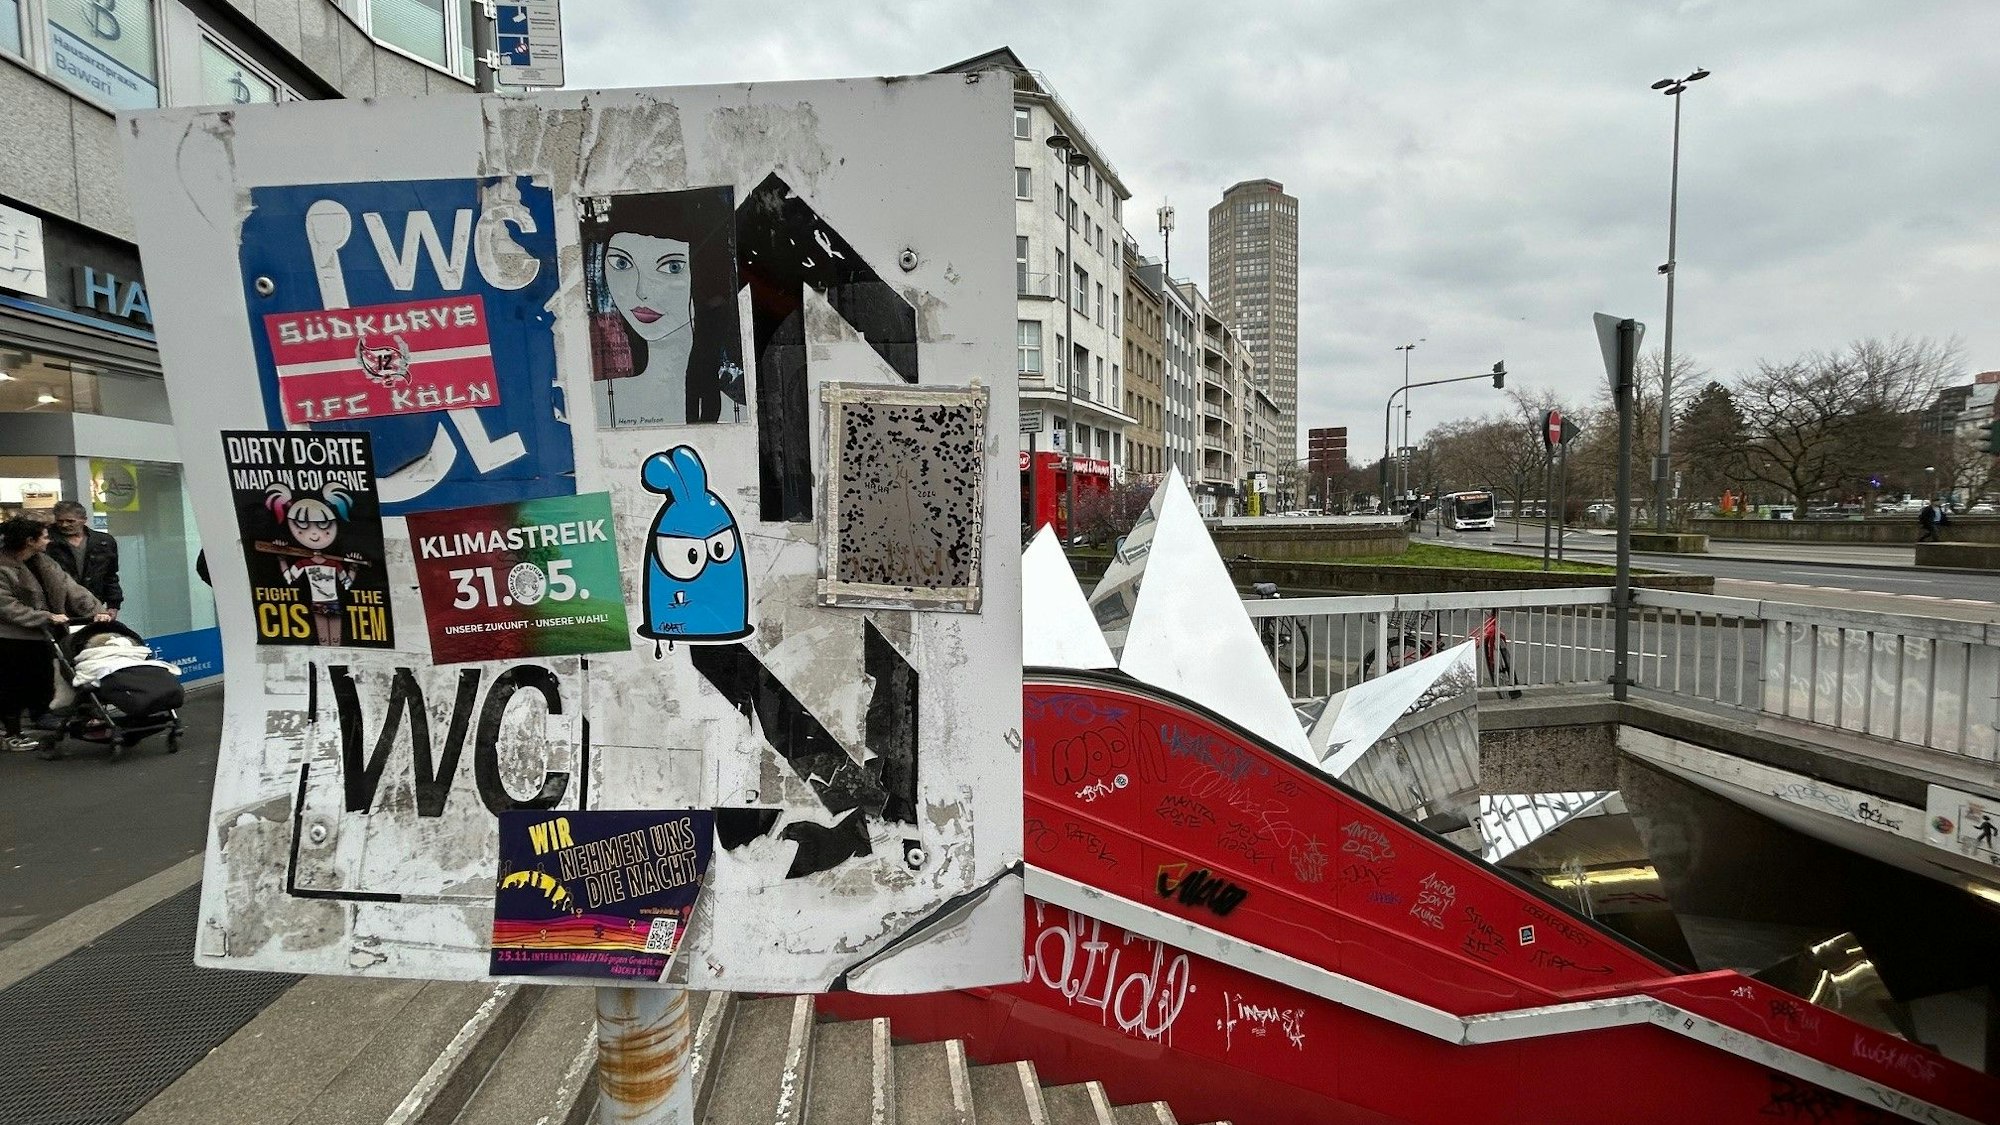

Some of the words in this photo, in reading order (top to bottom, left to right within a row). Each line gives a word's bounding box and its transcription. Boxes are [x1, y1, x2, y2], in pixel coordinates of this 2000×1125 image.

[53, 33, 138, 91] Hausarztpraxis
[55, 52, 113, 95] Bawari
[363, 206, 541, 291] WC
[278, 304, 478, 345] SÜDKURVE
[378, 354, 393, 371] 12
[391, 382, 492, 411] KÖLN
[227, 437, 286, 464] DIRTY
[291, 437, 366, 466] DÖRTE
[233, 469, 274, 490] MAID
[277, 470, 295, 490] IN
[419, 518, 608, 559] KLIMASTREIK
[513, 564, 525, 574] FOR
[525, 564, 544, 580] FUTURE
[255, 587, 300, 601] FIGHT
[350, 589, 383, 604] THE
[258, 603, 311, 639] CIS
[346, 605, 387, 642] TEM
[445, 623, 484, 635] UNSERE
[485, 620, 529, 632] ZUKUNFT
[535, 616, 575, 628] UNSERE
[575, 613, 609, 625] WAHL!
[328, 664, 570, 818] WC
[528, 817, 574, 855] WIR
[558, 829, 650, 882] NEHMEN
[649, 817, 696, 857] UNS
[584, 869, 626, 909] DIE
[626, 850, 697, 898] NACHT
[497, 951, 531, 961] 25.11.
[531, 952, 597, 962] INTERNATIONALER
